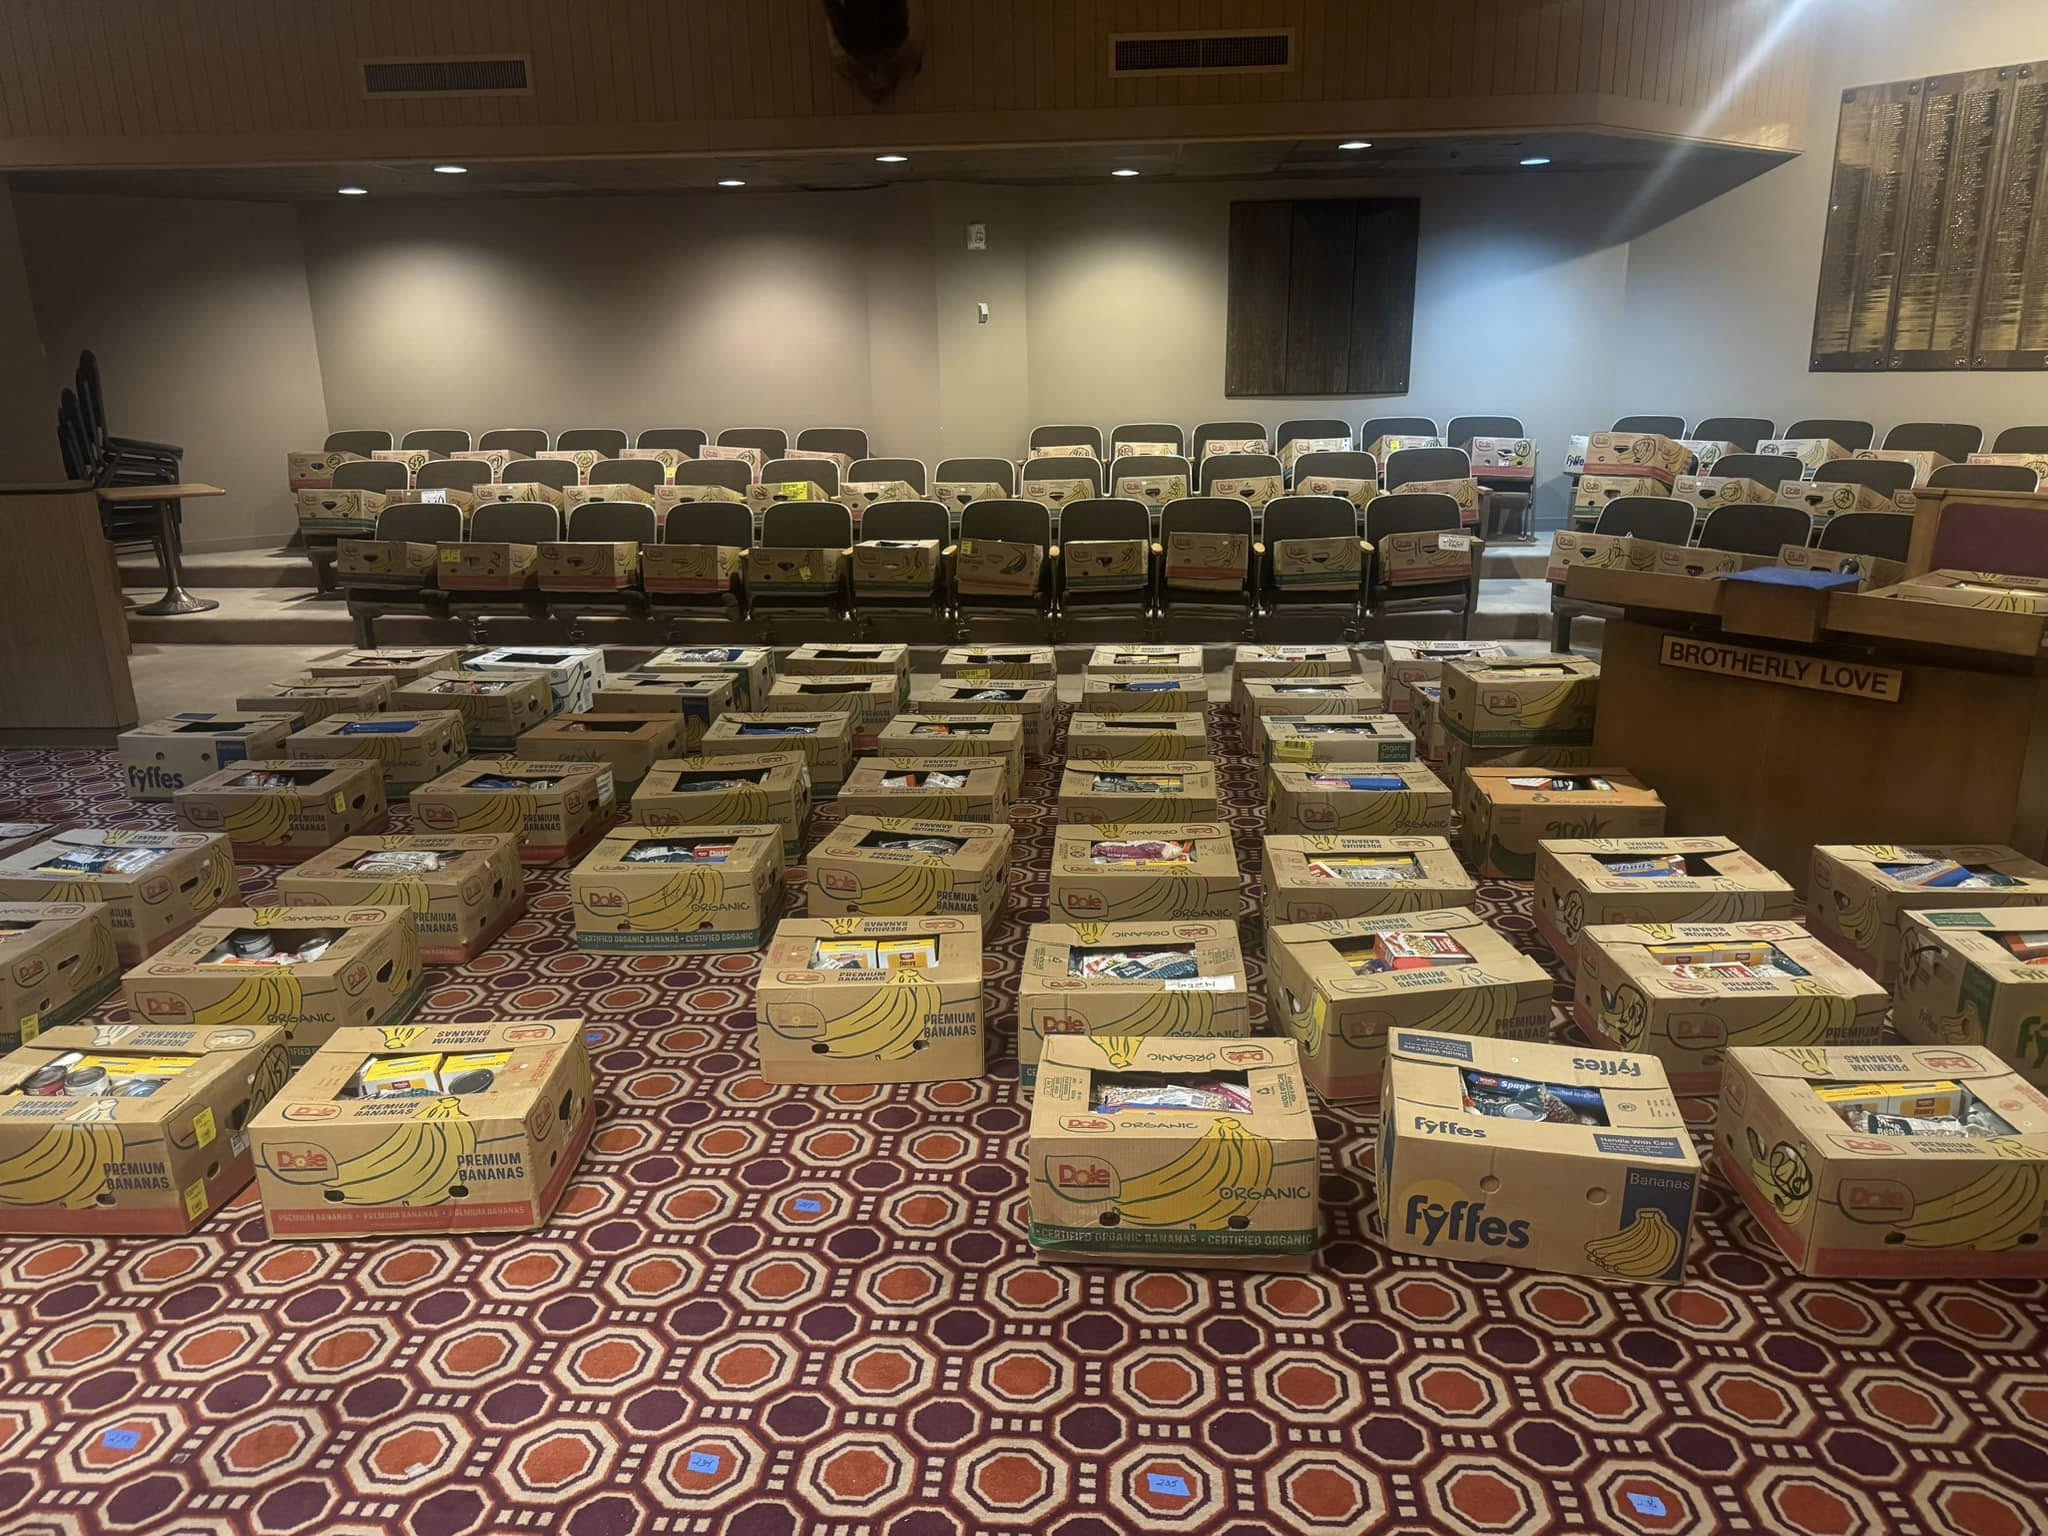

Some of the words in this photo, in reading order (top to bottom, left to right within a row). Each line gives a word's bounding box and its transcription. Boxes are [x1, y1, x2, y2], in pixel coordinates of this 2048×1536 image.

[1670, 642, 1812, 680] BROTHERLY
[1820, 664, 1889, 694] LOVE
[1490, 695, 1517, 706] Dole
[288, 815, 325, 823] PREMIUM
[524, 814, 560, 822] PREMIUM
[650, 814, 679, 824] Dole
[1304, 808, 1335, 819] Dole
[289, 823, 326, 832] BANANAS
[1396, 820, 1448, 828] ORGANIC
[826, 874, 857, 888] Dole
[589, 893, 622, 905] Dole
[937, 891, 978, 901] PREMIUM
[1068, 895, 1102, 907] Dole
[691, 902, 750, 912] ORGANIC
[937, 902, 978, 912] BANANAS
[413, 913, 456, 922] PREMIUM
[1173, 909, 1233, 917] ORGANIC
[1173, 909, 1233, 917] ORGANIC
[414, 923, 458, 933] BANANAS
[614, 935, 643, 943] ORGANIC
[646, 935, 679, 943] BANANAS
[686, 934, 720, 942] CERTIFIED
[722, 932, 753, 941] ORGANIC
[1392, 971, 1447, 982] PREMIUM
[1398, 978, 1452, 988] BANANAS
[146, 998, 186, 1012] Dole
[267, 1013, 336, 1024] ORGANIC
[924, 1013, 976, 1024] PREMIUM
[1043, 1016, 1084, 1032] Dole
[1496, 1016, 1546, 1028] PREMIUM
[924, 1025, 977, 1037] BANANAS
[1825, 1026, 1879, 1039] PREMIUM
[129, 1039, 188, 1047] PREMIUM
[1147, 1052, 1216, 1061] ORGANIC
[1229, 1051, 1264, 1061] Dole
[1844, 1055, 1902, 1063] BANANAS
[1852, 1064, 1910, 1072] PREMIUM
[1925, 1057, 1972, 1069] Dole
[360, 1102, 420, 1110] PREMIUM
[353, 1109, 414, 1117] BANANAS
[1067, 1120, 1108, 1128] Dole
[277, 1150, 329, 1168] Dole
[457, 1153, 521, 1166] PREMIUM
[103, 1163, 166, 1175] PREMIUM
[459, 1167, 524, 1181] BANANAS
[1059, 1164, 1111, 1185] Dole
[106, 1177, 170, 1189] BANANAS
[1630, 1172, 1690, 1190] Bananas
[1219, 1187, 1311, 1200] ORGANIC
[1041, 1229, 1091, 1240] CERTIFIED
[1096, 1232, 1141, 1242] ORGANIC
[1144, 1232, 1197, 1243] BANANAS
[1208, 1235, 1261, 1245] CERTIFIED
[1264, 1235, 1312, 1245] ORGANIC
